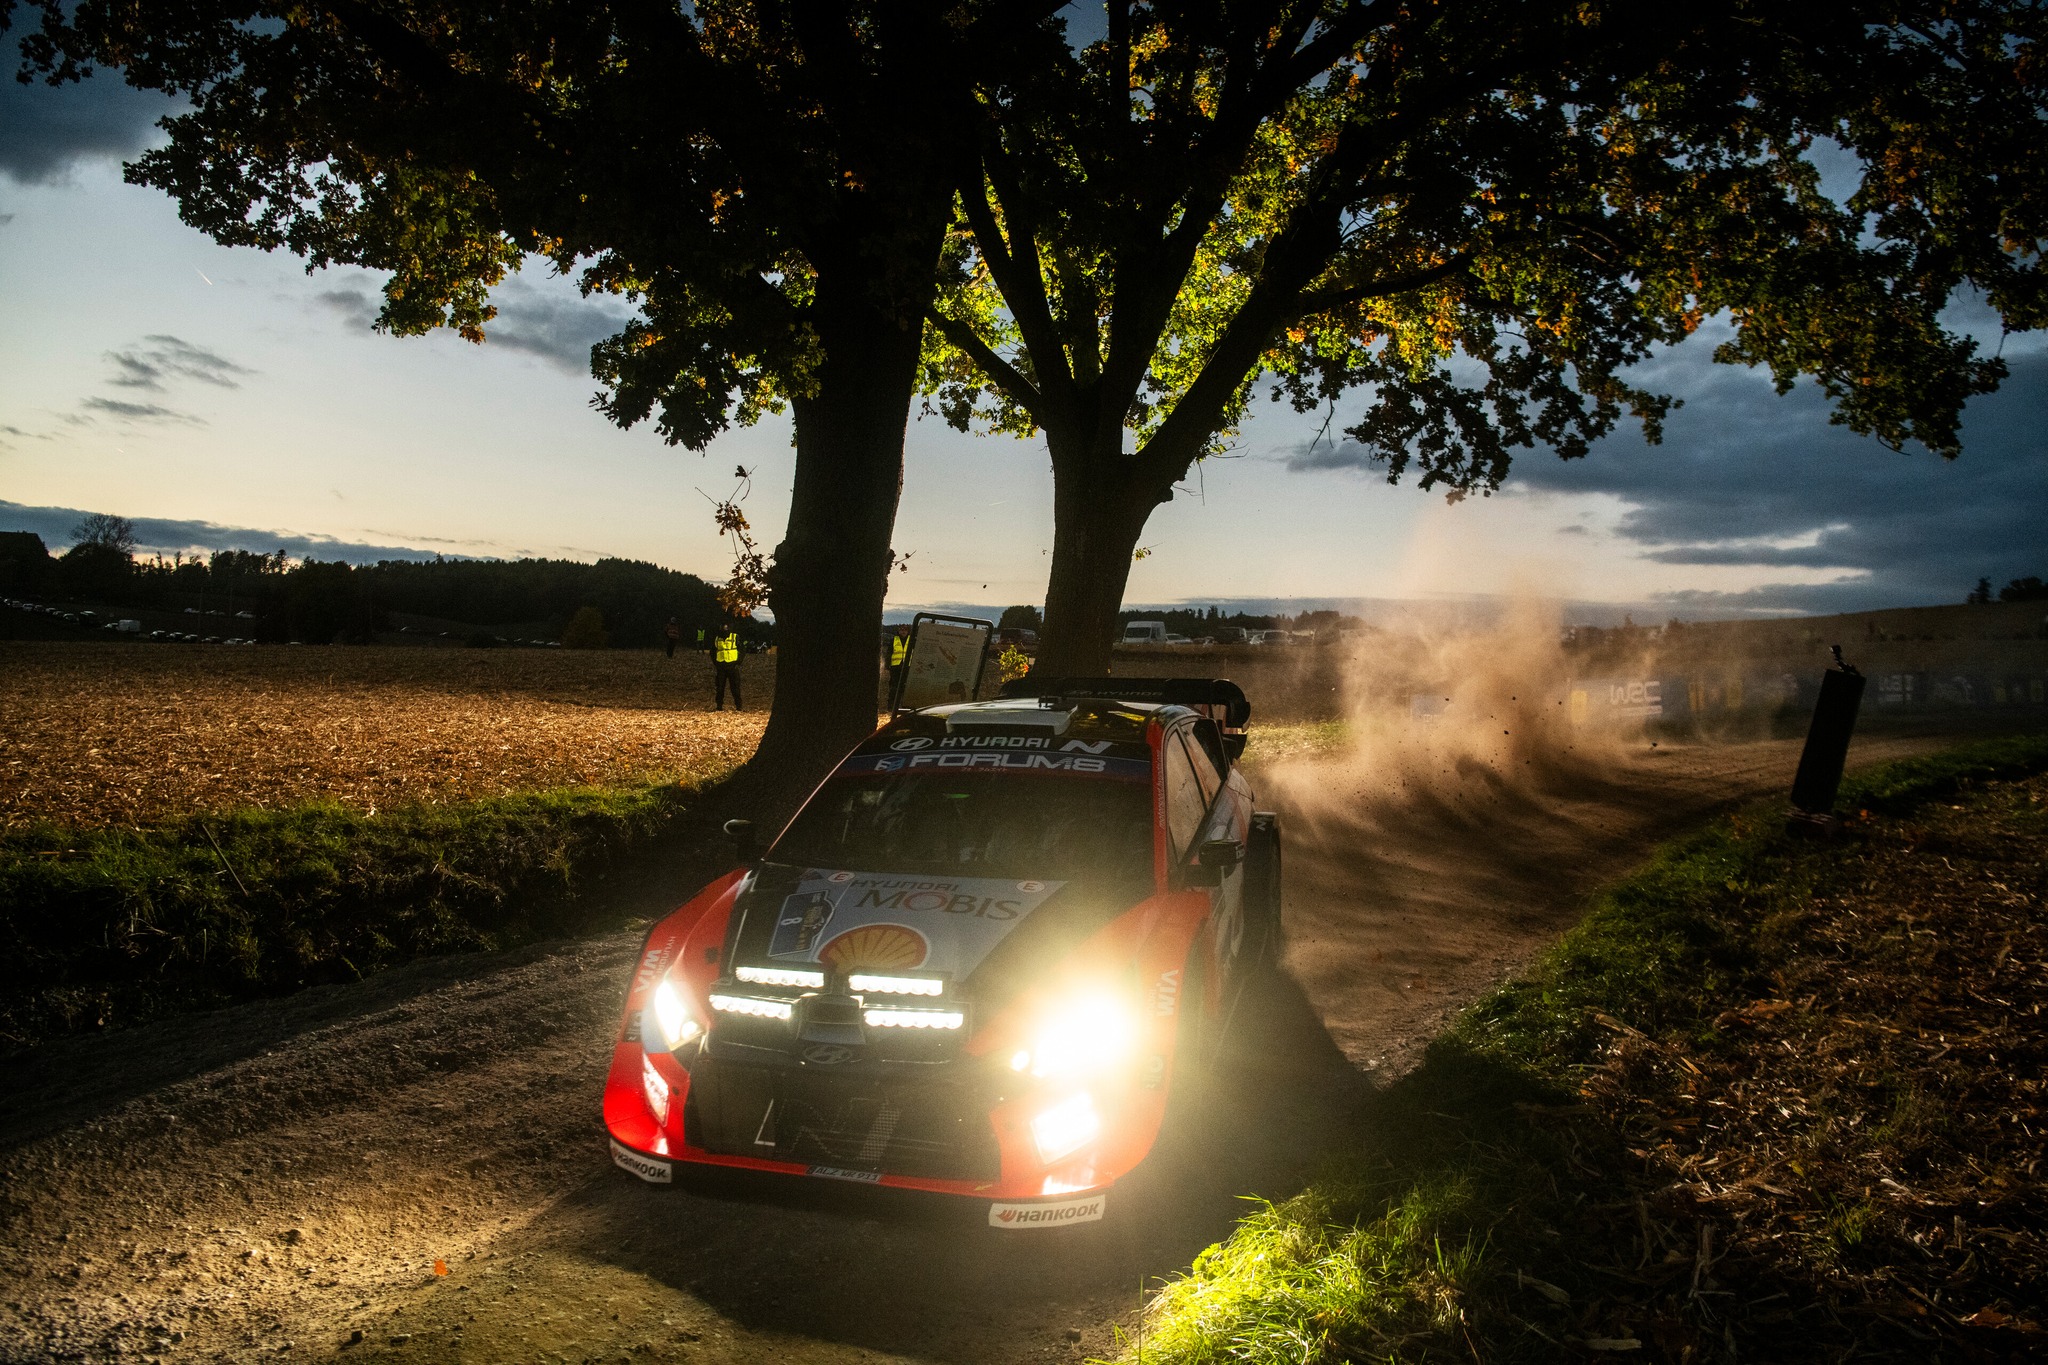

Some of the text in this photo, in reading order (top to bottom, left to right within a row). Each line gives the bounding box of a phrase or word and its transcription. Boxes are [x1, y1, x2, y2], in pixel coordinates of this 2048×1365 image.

[939, 736, 1050, 748] HYUNDAI
[908, 753, 1107, 772] FORUM8
[835, 872, 849, 882] E
[851, 878, 959, 893] HYUNDAI
[1023, 881, 1039, 892] E
[853, 888, 1023, 922] MOBIS
[780, 916, 803, 926] 8
[634, 949, 662, 993] WIA
[1155, 969, 1179, 1017] WIA
